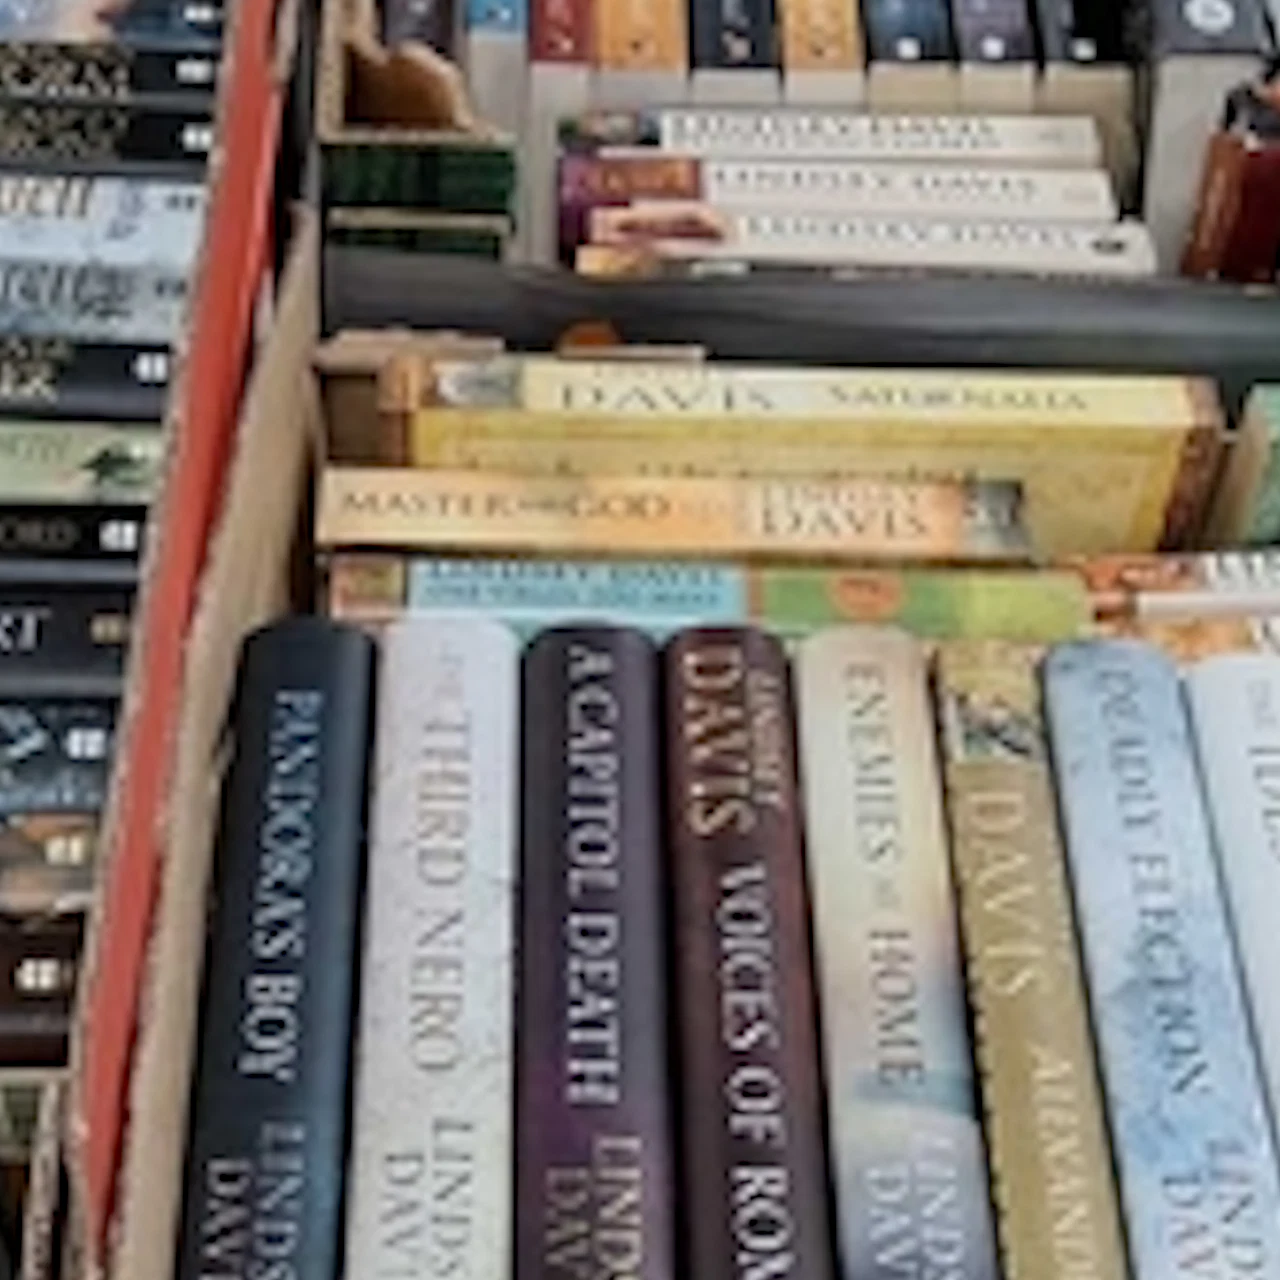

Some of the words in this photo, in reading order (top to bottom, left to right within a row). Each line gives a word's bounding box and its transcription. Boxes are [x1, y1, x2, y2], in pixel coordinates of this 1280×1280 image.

[561, 380, 778, 414] DAVIS
[339, 488, 504, 521] MASTER
[566, 492, 674, 522] GOD
[758, 507, 933, 539] DAVIS
[565, 643, 613, 685] A
[680, 642, 751, 839] DAVIS
[413, 718, 474, 891] THIRD
[564, 690, 622, 900] CAPITOL
[841, 662, 906, 867] ENEMIES
[717, 860, 782, 1054] VOICES
[967, 786, 1050, 1002] DAVIS
[238, 971, 300, 1085] BOY
[408, 908, 469, 1076] NERO
[564, 914, 622, 1110] DEATH
[869, 928, 926, 1091] HOME
[728, 1066, 788, 1152] OF
